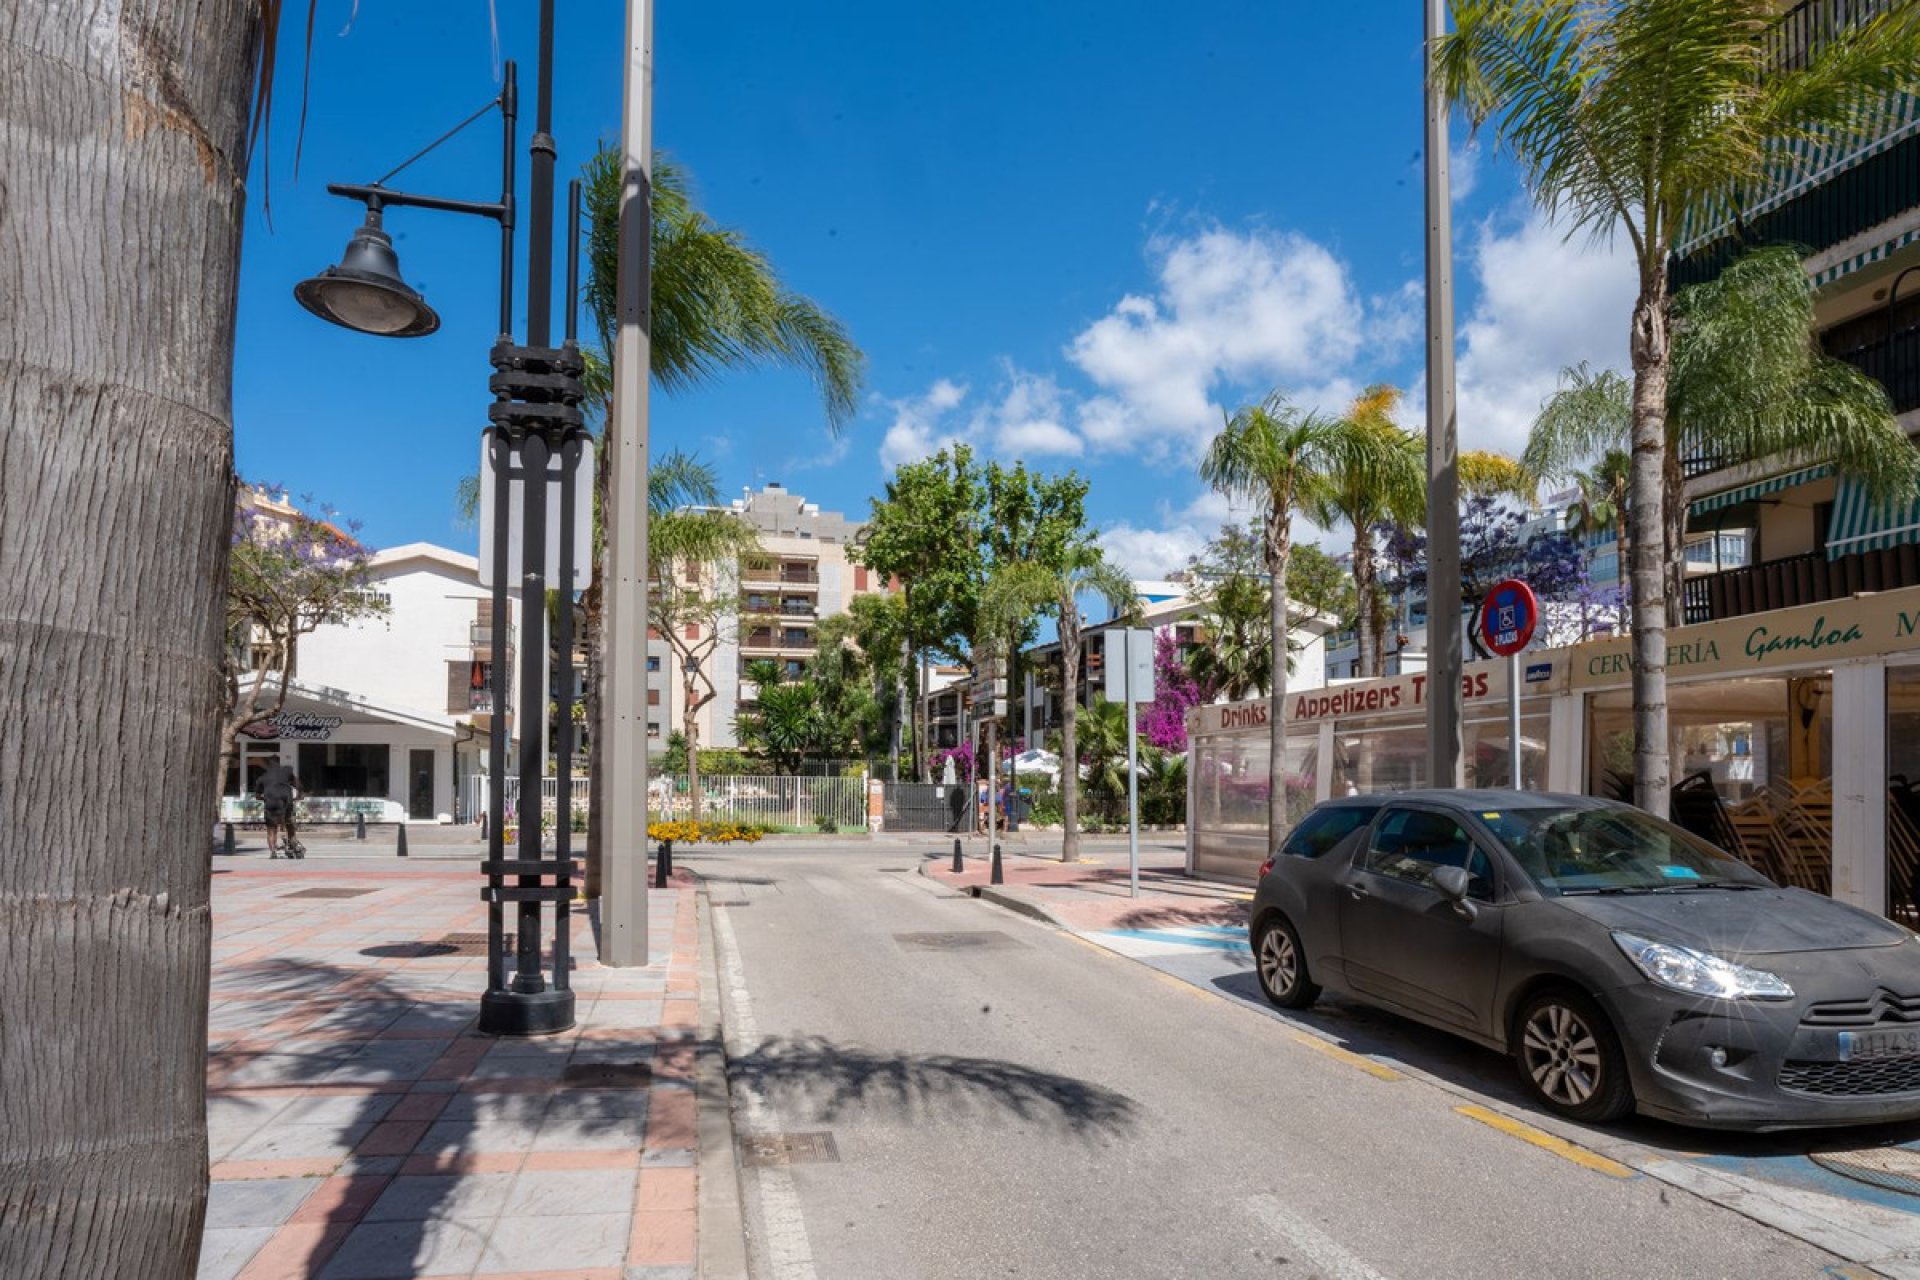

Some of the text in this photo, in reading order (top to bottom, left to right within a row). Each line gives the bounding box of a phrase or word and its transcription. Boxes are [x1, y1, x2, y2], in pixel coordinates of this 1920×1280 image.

[1745, 616, 1863, 661] Gamboa
[1221, 672, 1489, 729] Drinks Appetizers Tas
[269, 712, 341, 729] Autohaus
[280, 726, 331, 740] Beach
